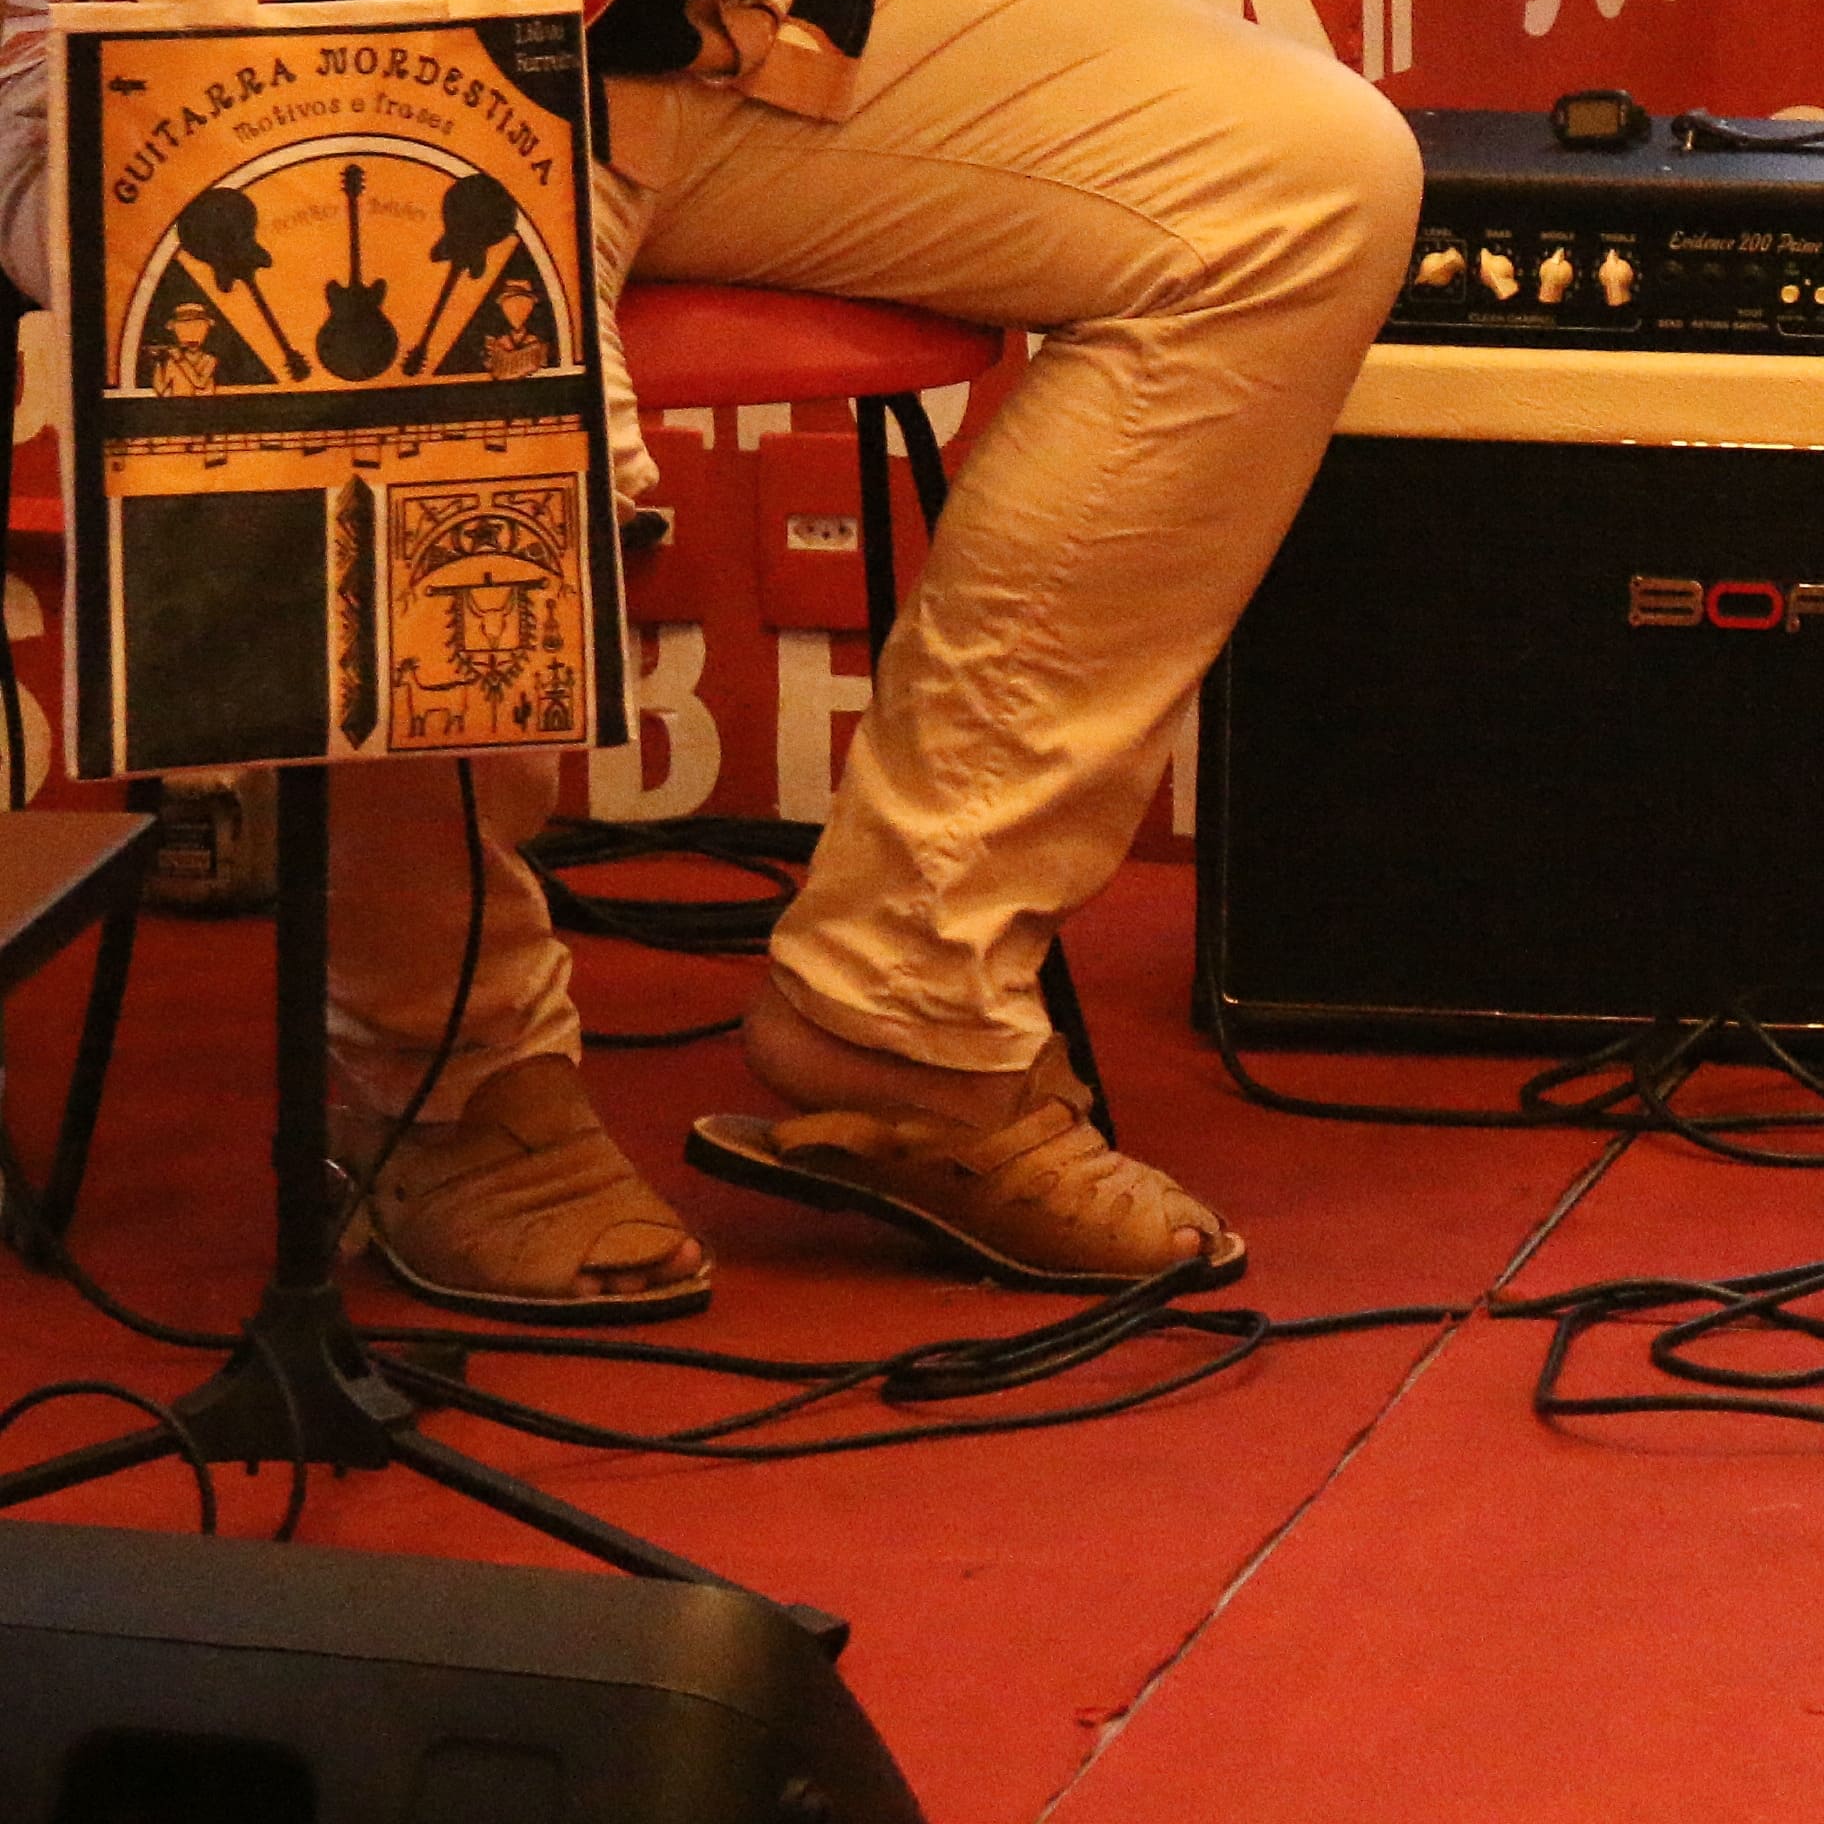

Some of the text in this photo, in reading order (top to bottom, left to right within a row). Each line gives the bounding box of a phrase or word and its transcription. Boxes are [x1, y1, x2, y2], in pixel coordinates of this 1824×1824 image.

[113, 45, 553, 205] GUITARRA NORDESTINA
[231, 97, 342, 144] Motivos
[350, 94, 368, 115] e
[1738, 232, 1773, 253] 200
